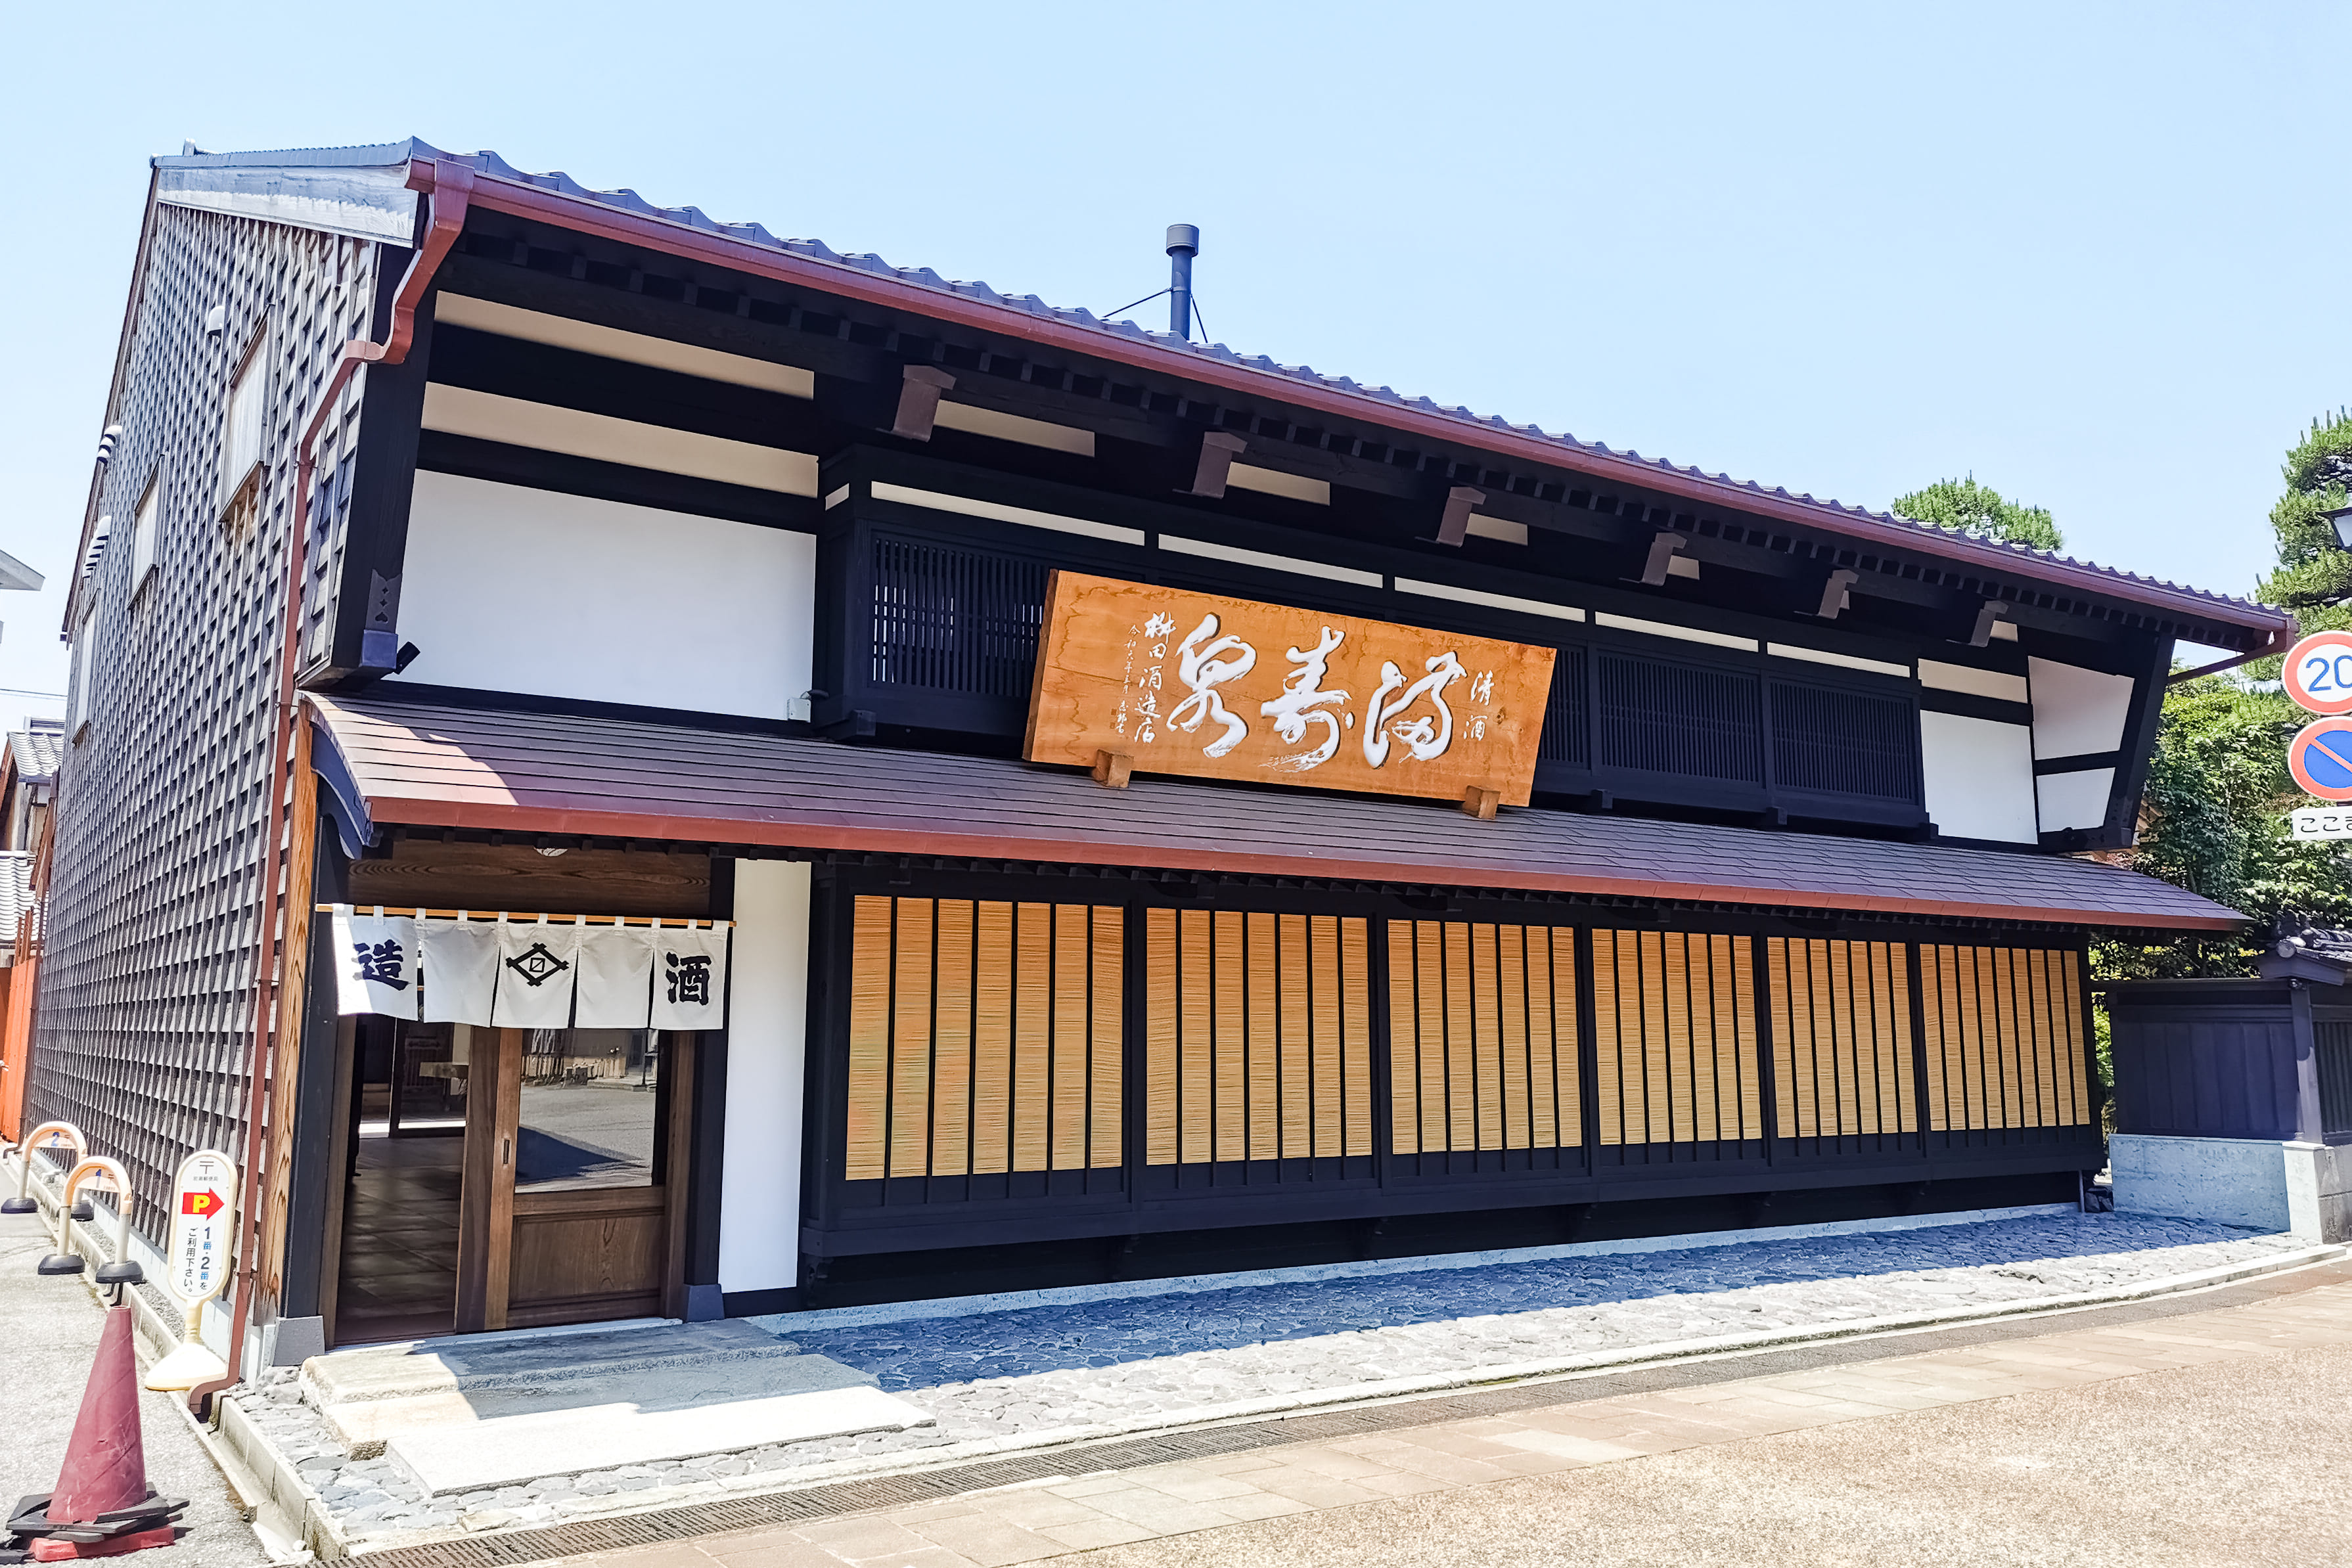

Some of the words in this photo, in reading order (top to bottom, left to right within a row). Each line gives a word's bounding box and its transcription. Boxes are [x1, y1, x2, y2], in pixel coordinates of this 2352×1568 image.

[2305, 655, 2352, 692] 20
[1463, 670, 1495, 741] 清酒
[351, 939, 412, 991] 造
[666, 951, 712, 1006] 酒
[51, 1131, 60, 1147] 2
[95, 1169, 102, 1188] 1
[192, 1194, 211, 1213] P
[184, 1227, 198, 1292] ご利用下さい。
